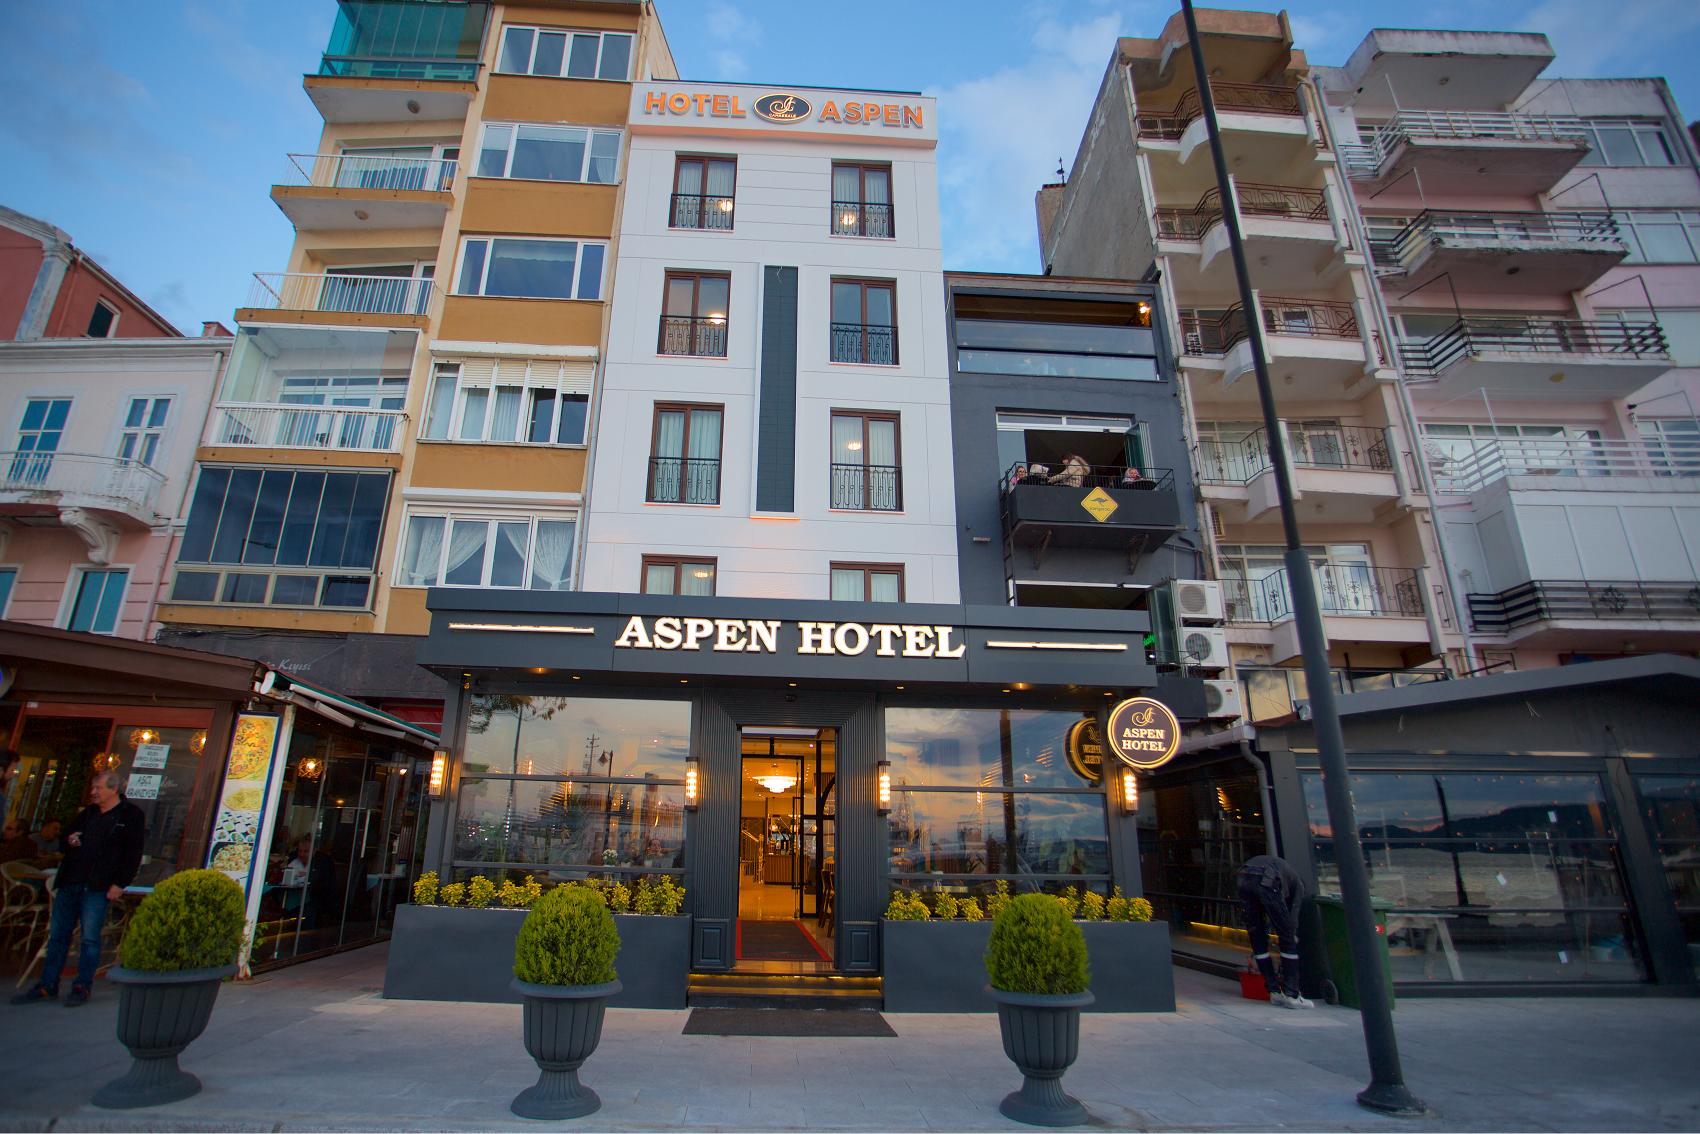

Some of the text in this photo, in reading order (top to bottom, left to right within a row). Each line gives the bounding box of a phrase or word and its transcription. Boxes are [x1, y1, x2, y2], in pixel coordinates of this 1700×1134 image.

[645, 91, 923, 128] HOTEL ASPEN
[614, 615, 966, 659] ASPEN HOTEL
[1121, 739, 1167, 752] HOTEL
[1122, 727, 1165, 740] ASPEN
